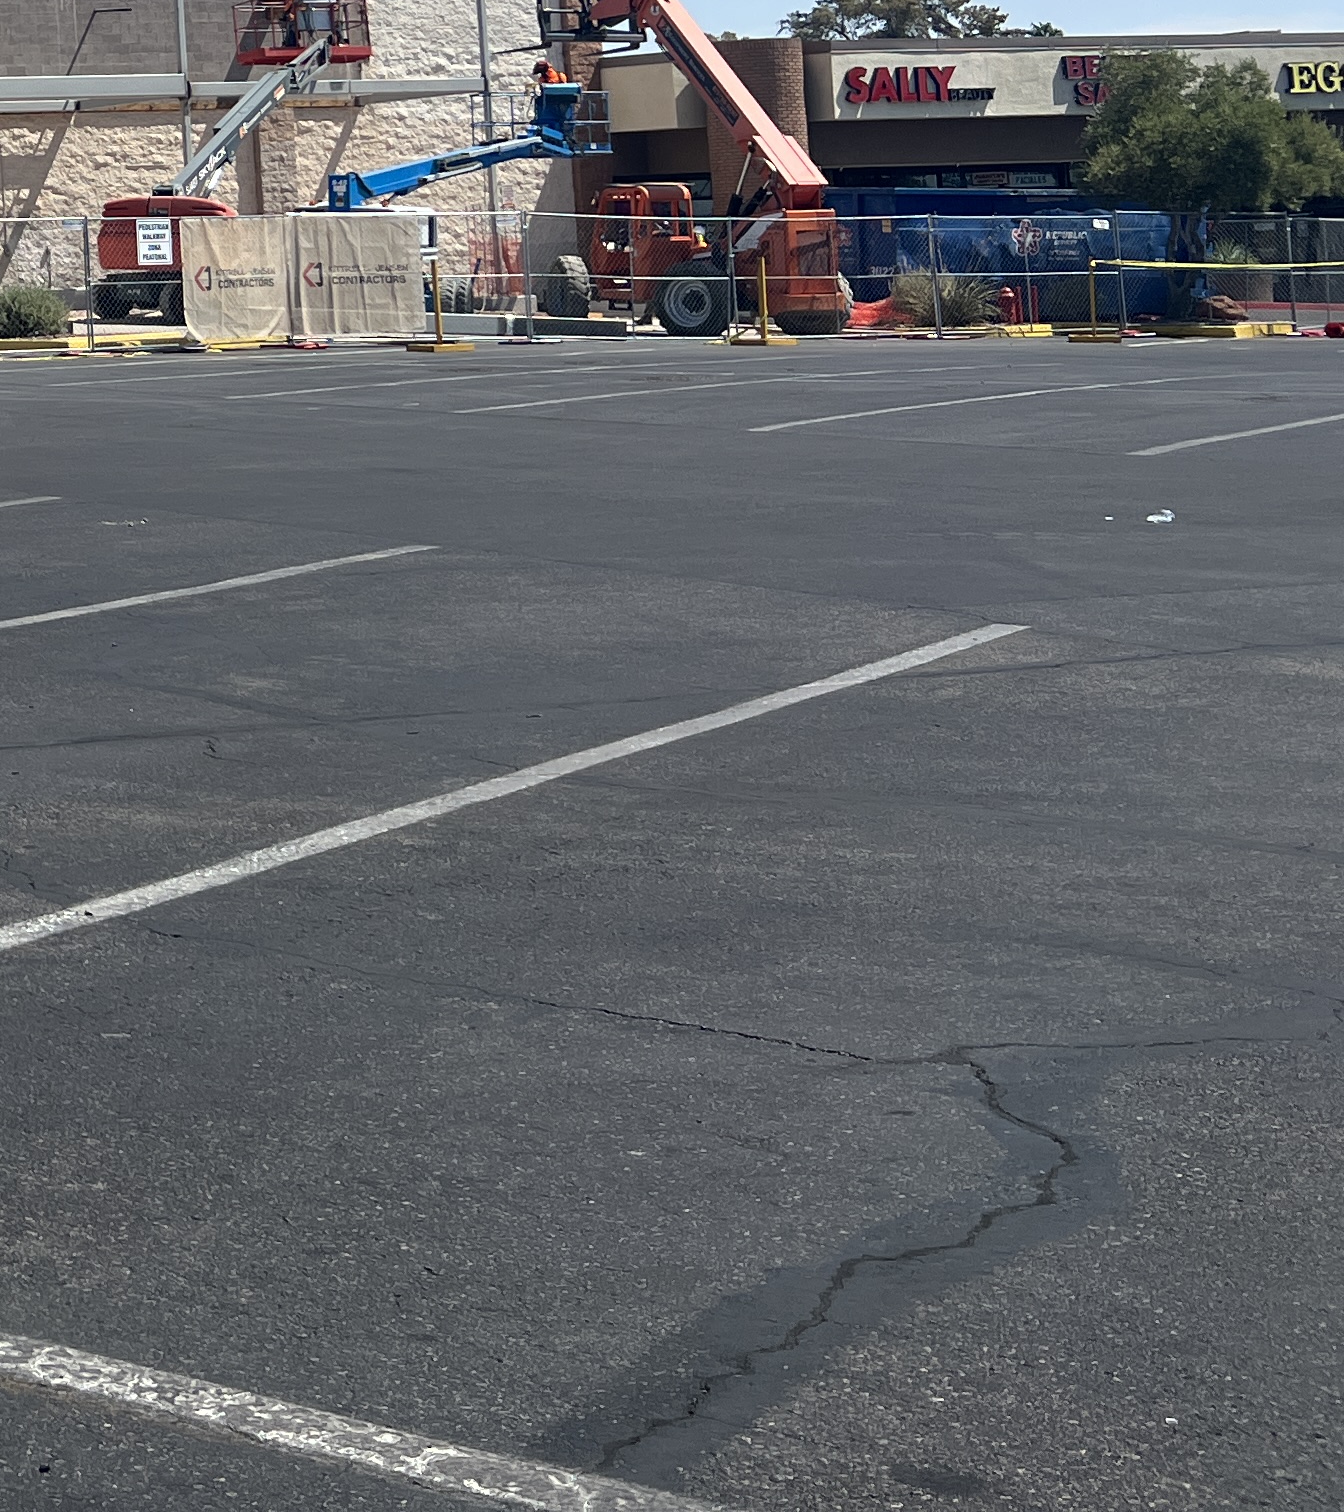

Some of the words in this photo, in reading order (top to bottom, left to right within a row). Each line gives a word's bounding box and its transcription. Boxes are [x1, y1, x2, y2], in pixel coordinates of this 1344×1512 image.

[845, 65, 956, 104] SALLY
[950, 88, 996, 100] BEAUTY
[375, 263, 409, 272] JENSEN
[217, 277, 275, 289] CONTRACTORS
[331, 274, 407, 285] CONTRACTORS
